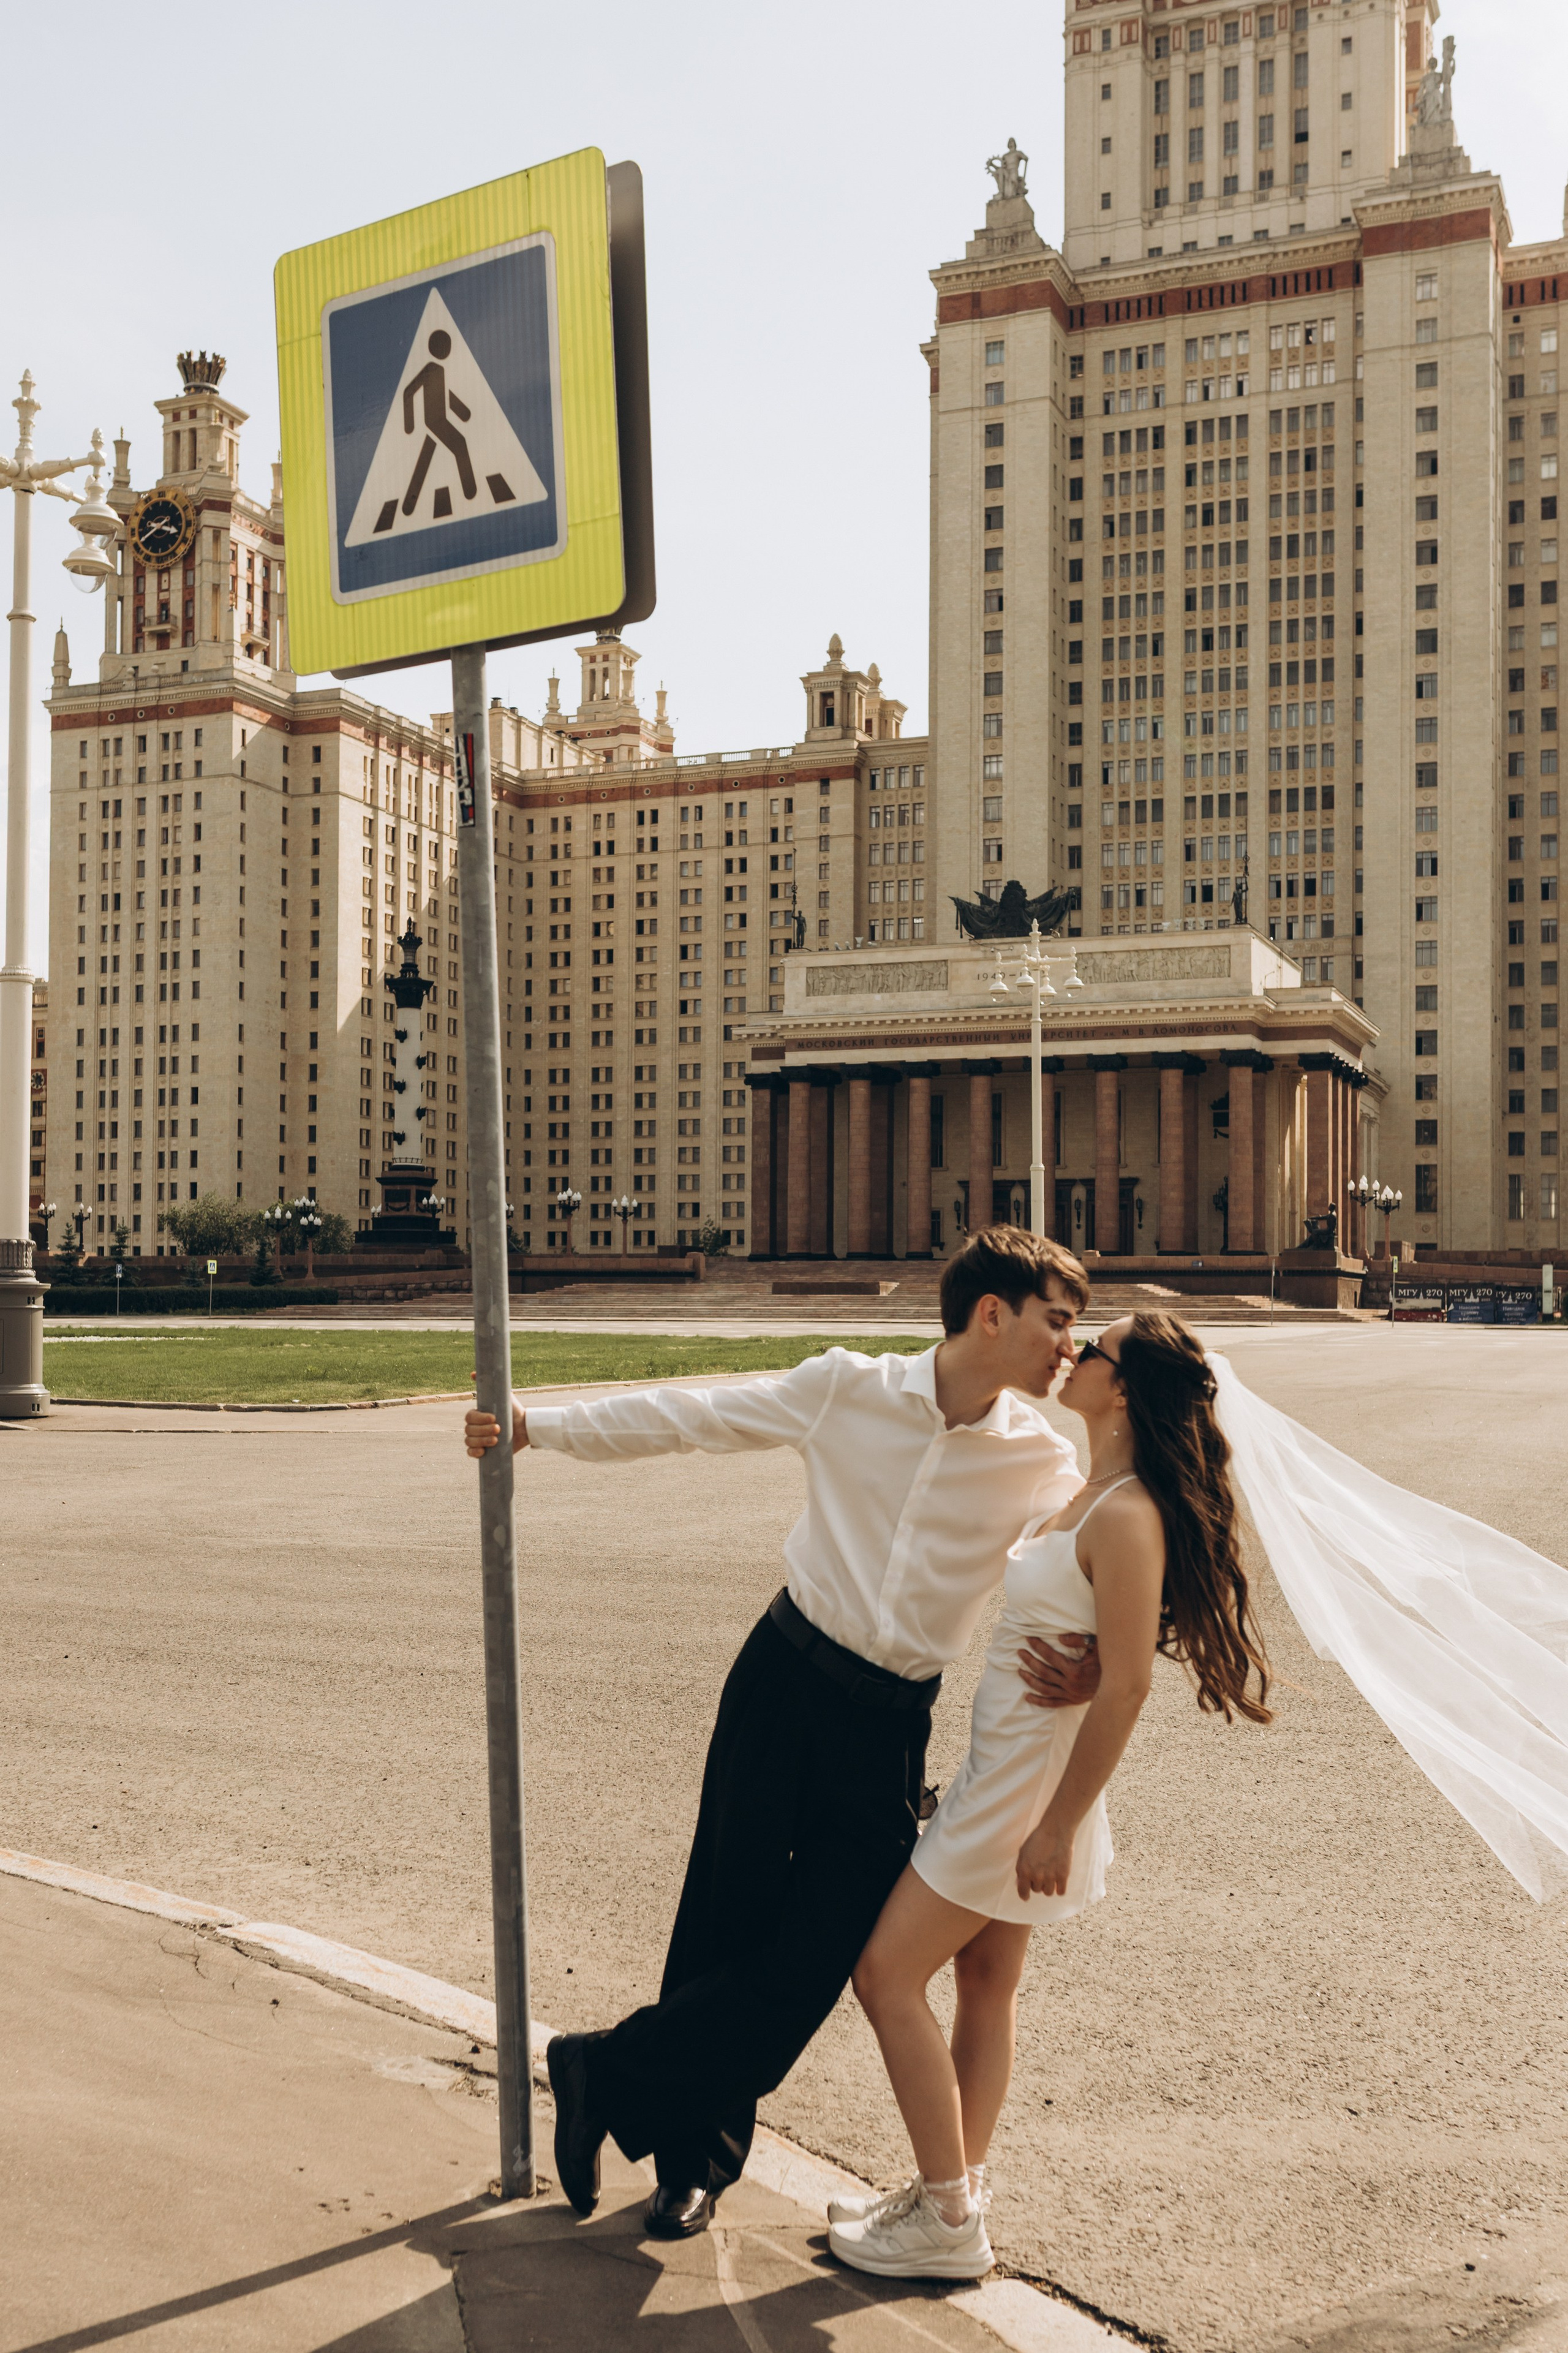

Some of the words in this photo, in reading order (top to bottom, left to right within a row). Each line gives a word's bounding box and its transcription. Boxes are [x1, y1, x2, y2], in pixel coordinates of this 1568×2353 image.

[1010, 1030, 1096, 1040] УНИЕРСИТЕТ
[1152, 1024, 1236, 1035] ЛОМОНОСОВА
[1515, 1291, 1532, 1300] 270
